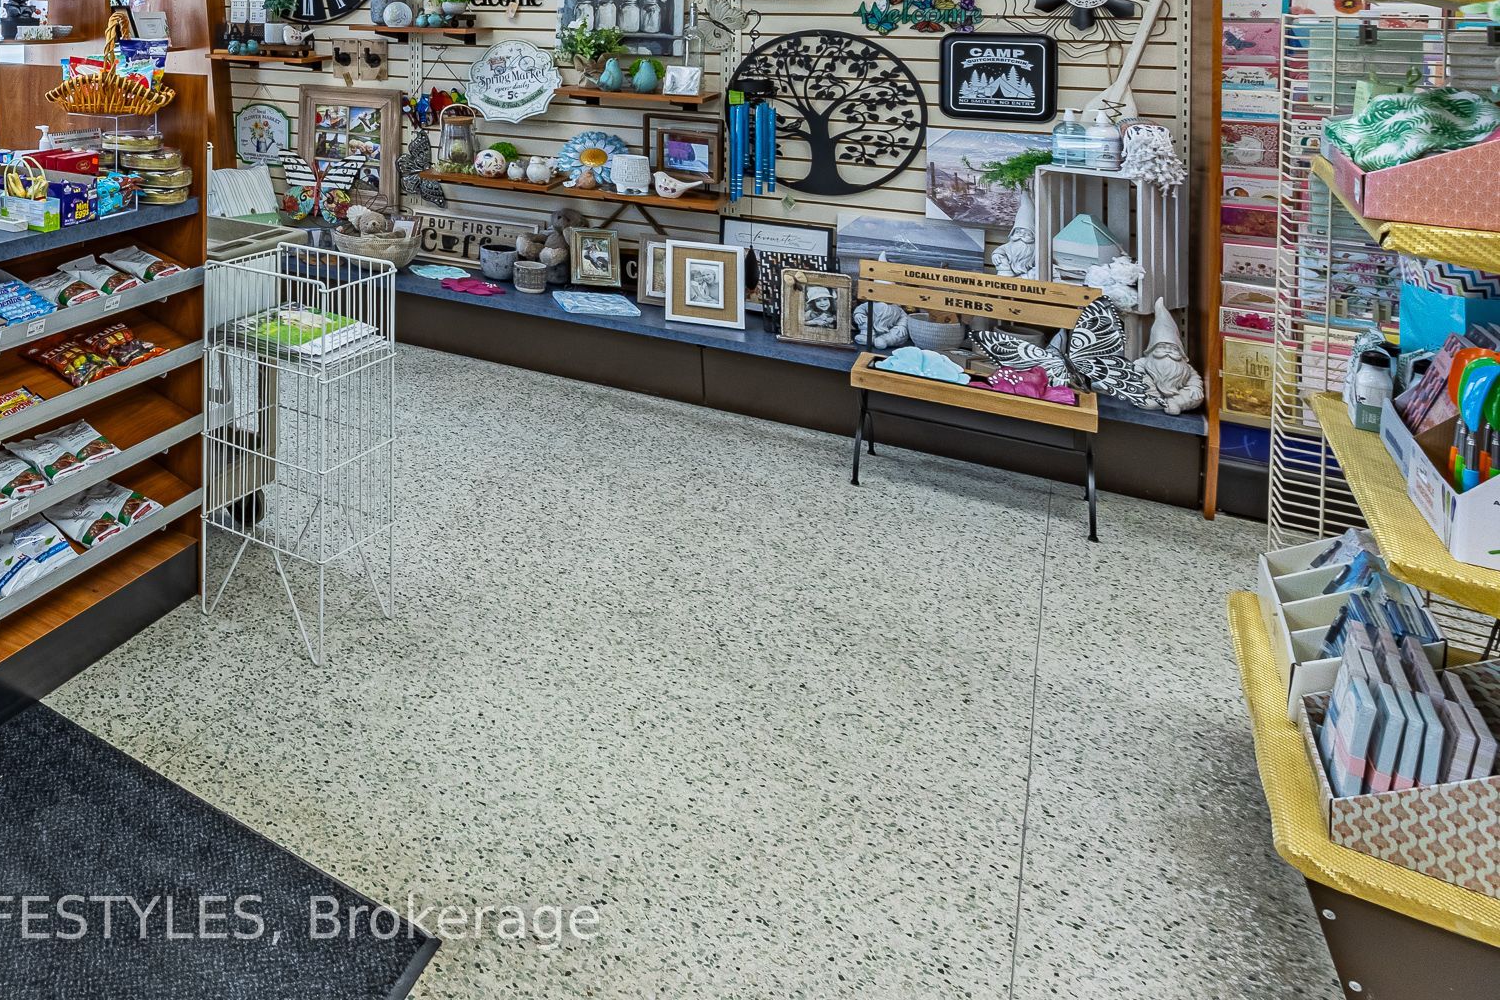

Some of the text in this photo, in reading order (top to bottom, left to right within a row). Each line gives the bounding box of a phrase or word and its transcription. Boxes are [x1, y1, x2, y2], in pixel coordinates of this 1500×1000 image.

[970, 48, 1025, 57] CAMP
[477, 68, 548, 93] Spring Market
[429, 218, 455, 230] BUT
[905, 270, 941, 280] LOCALLY
[943, 275, 975, 286] GROWN
[985, 279, 1018, 291] PICKED
[1021, 284, 1046, 295] DAILY
[945, 297, 994, 312] HERBS
